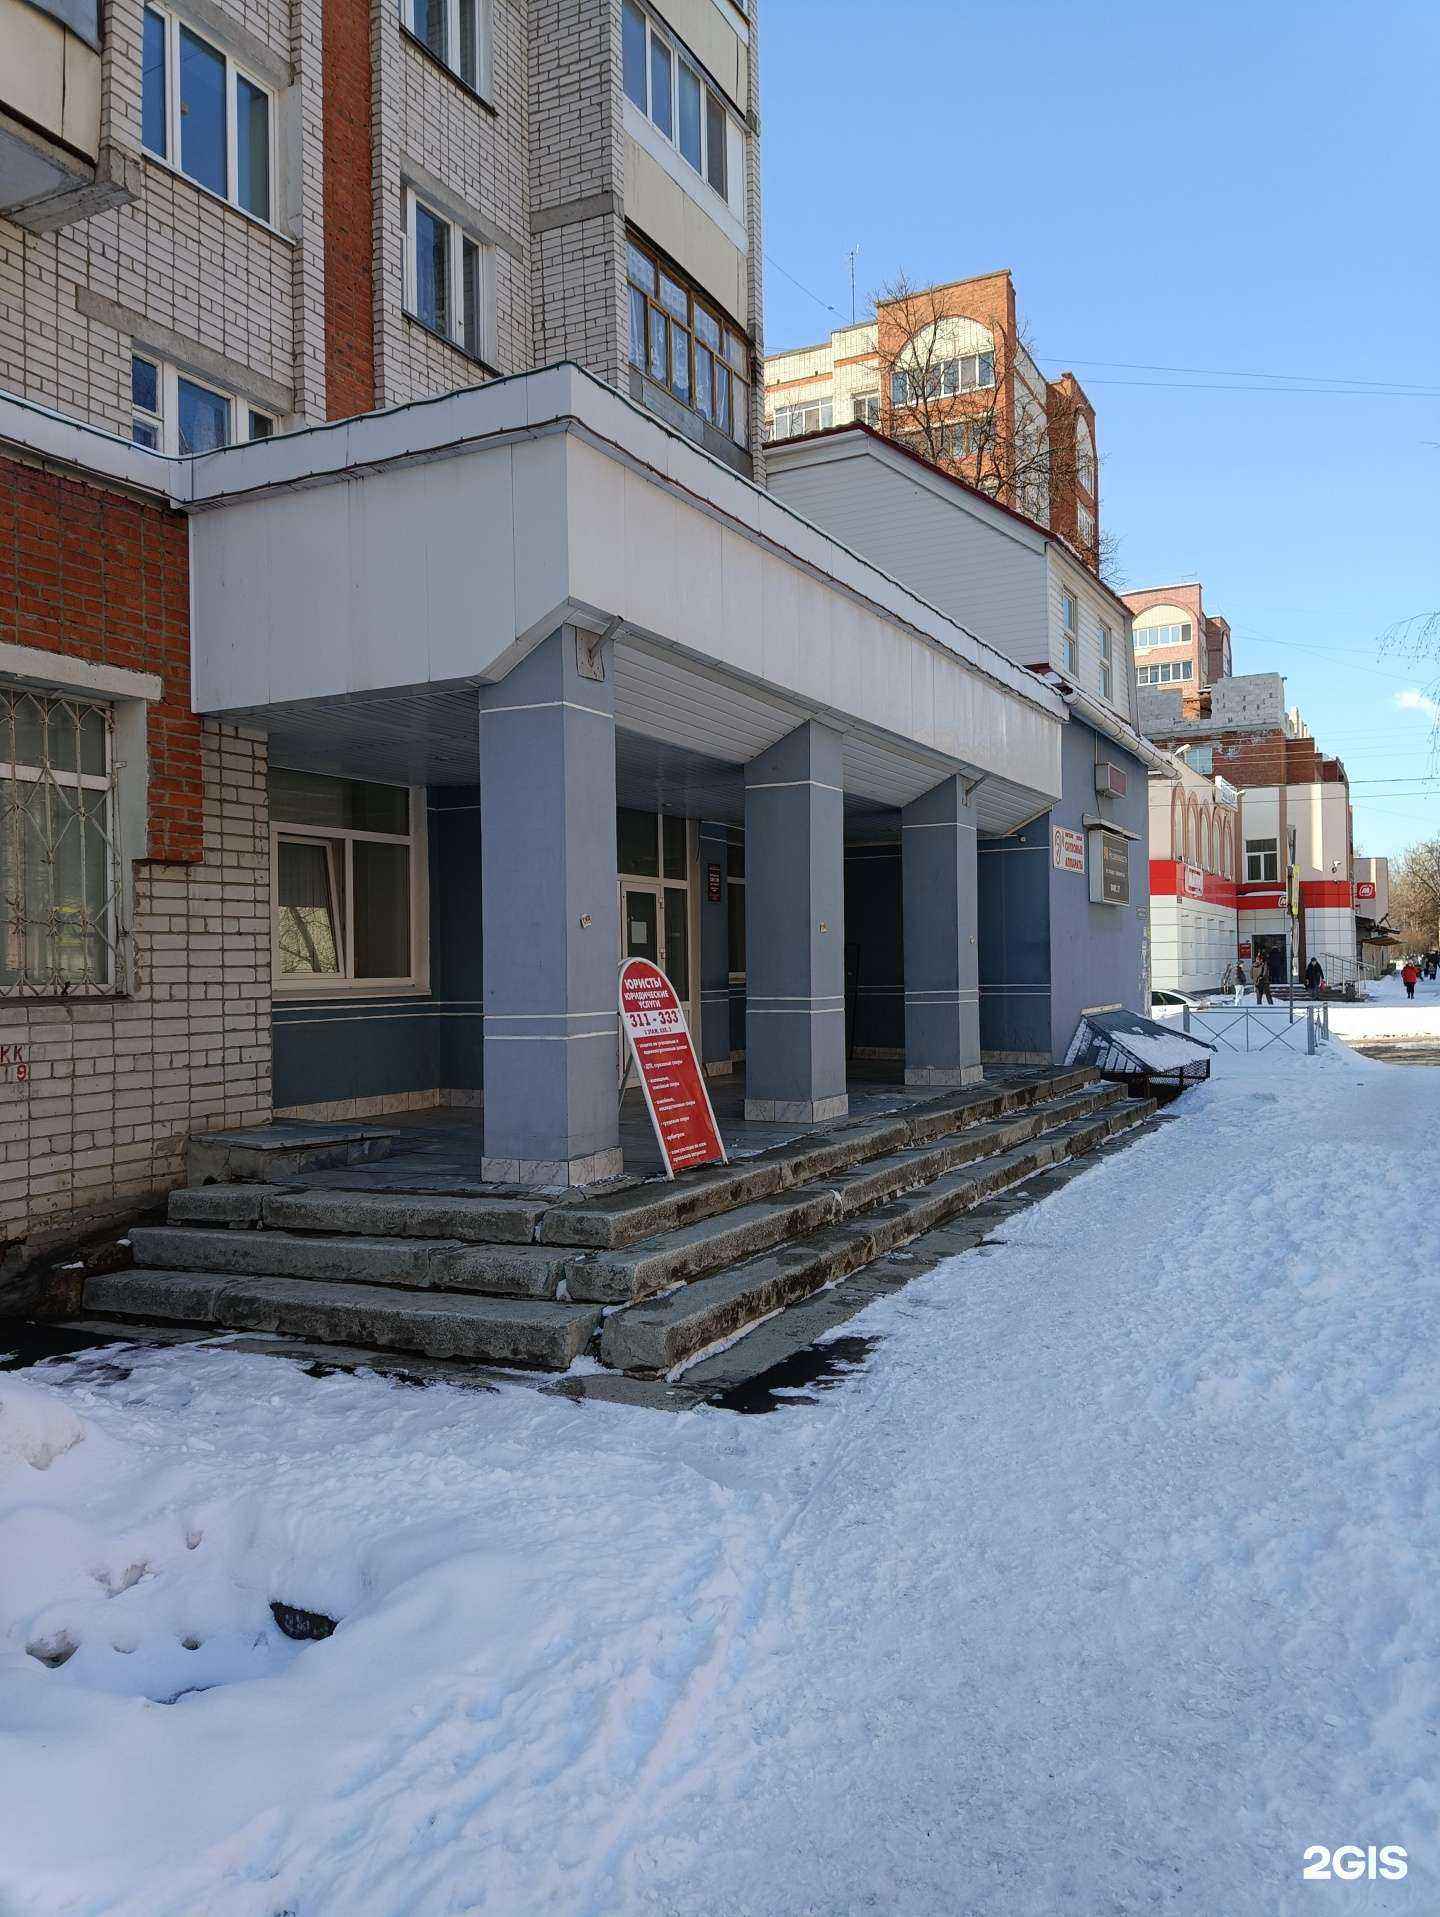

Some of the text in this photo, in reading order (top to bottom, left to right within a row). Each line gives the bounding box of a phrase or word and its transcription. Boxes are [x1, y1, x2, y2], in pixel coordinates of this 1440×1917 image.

[624, 978, 662, 989] ЮРИСТЫ
[624, 991, 669, 1000] ЮРИДИЧЕСКИЕ
[639, 1000, 661, 1008] УСЛУГИ
